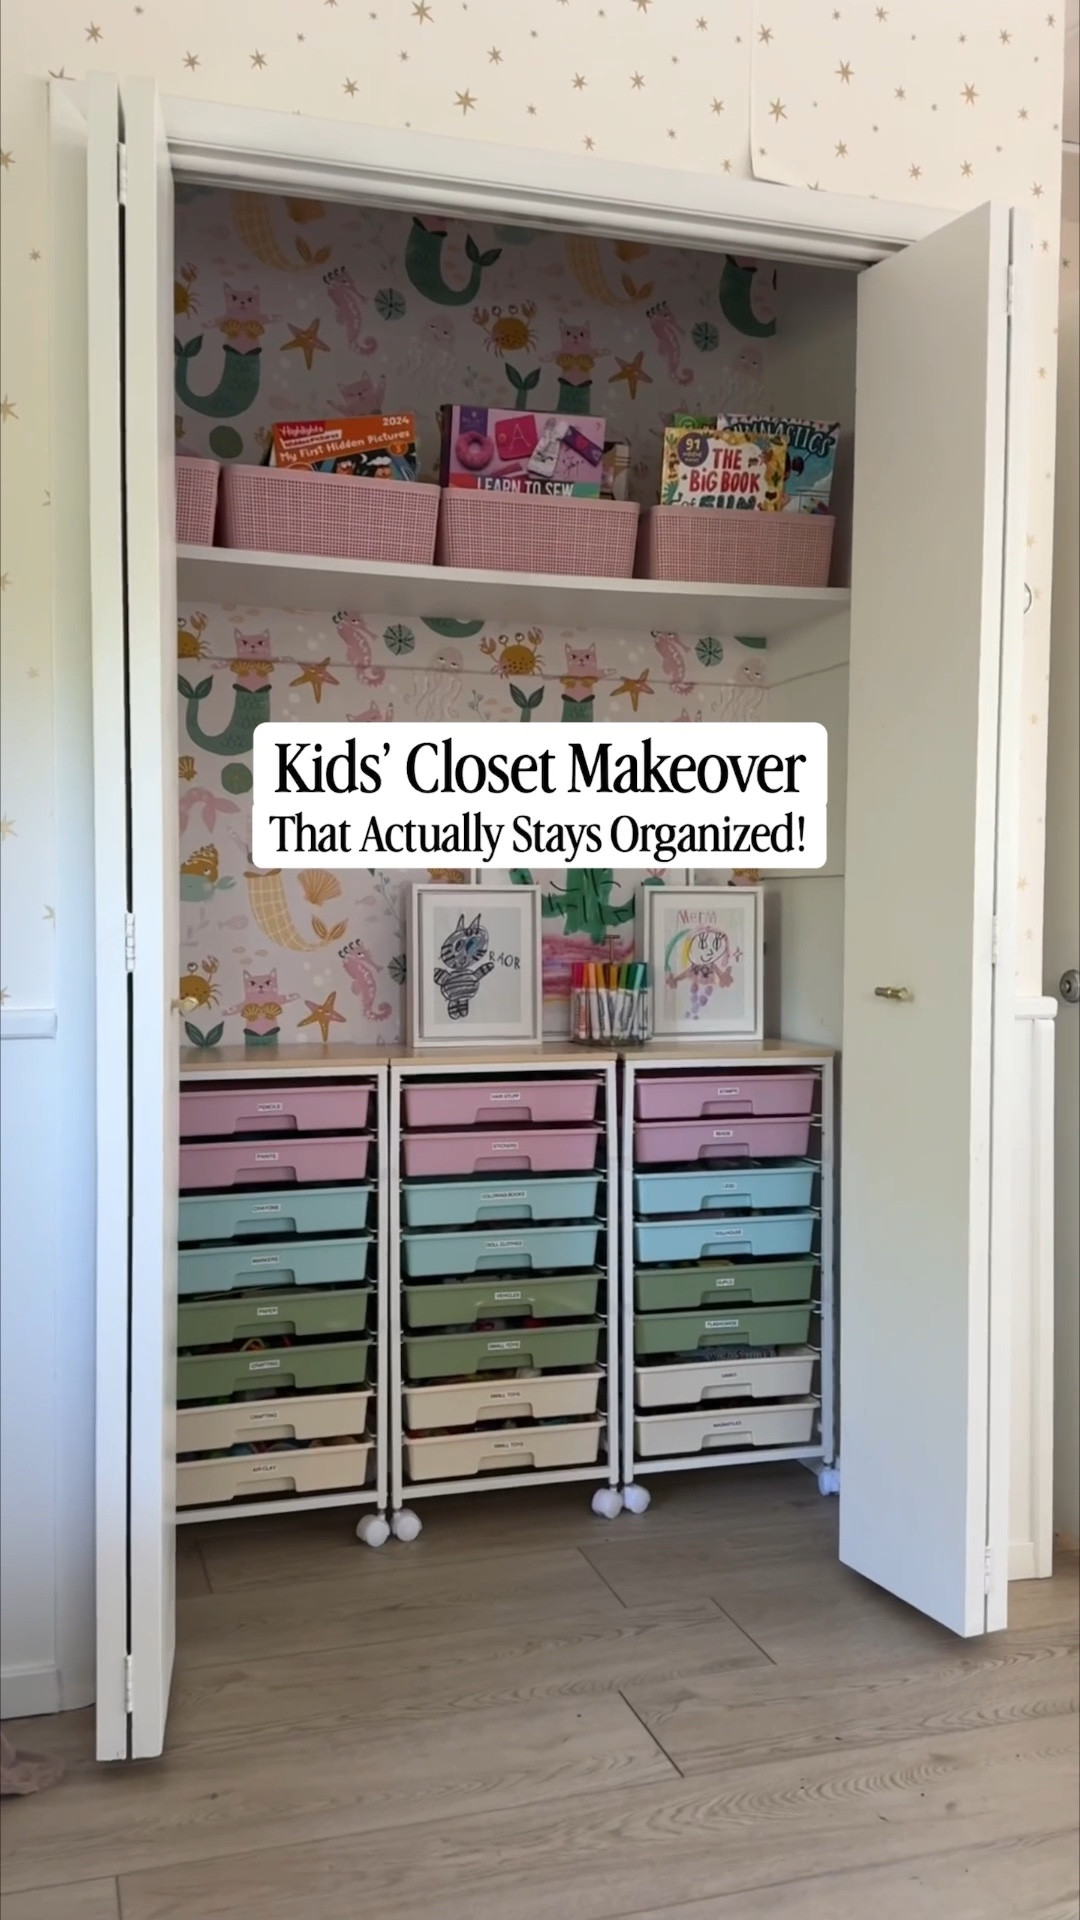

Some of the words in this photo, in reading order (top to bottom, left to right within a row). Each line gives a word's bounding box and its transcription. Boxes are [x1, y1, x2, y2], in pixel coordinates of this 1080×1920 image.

[382, 415, 410, 426] 2024
[279, 452, 297, 462] My
[299, 445, 325, 459] First
[326, 439, 365, 452] Hidden
[367, 430, 410, 442] Pictures
[685, 437, 700, 450] 91
[712, 448, 742, 470] THE
[720, 471, 761, 494] BOOK
